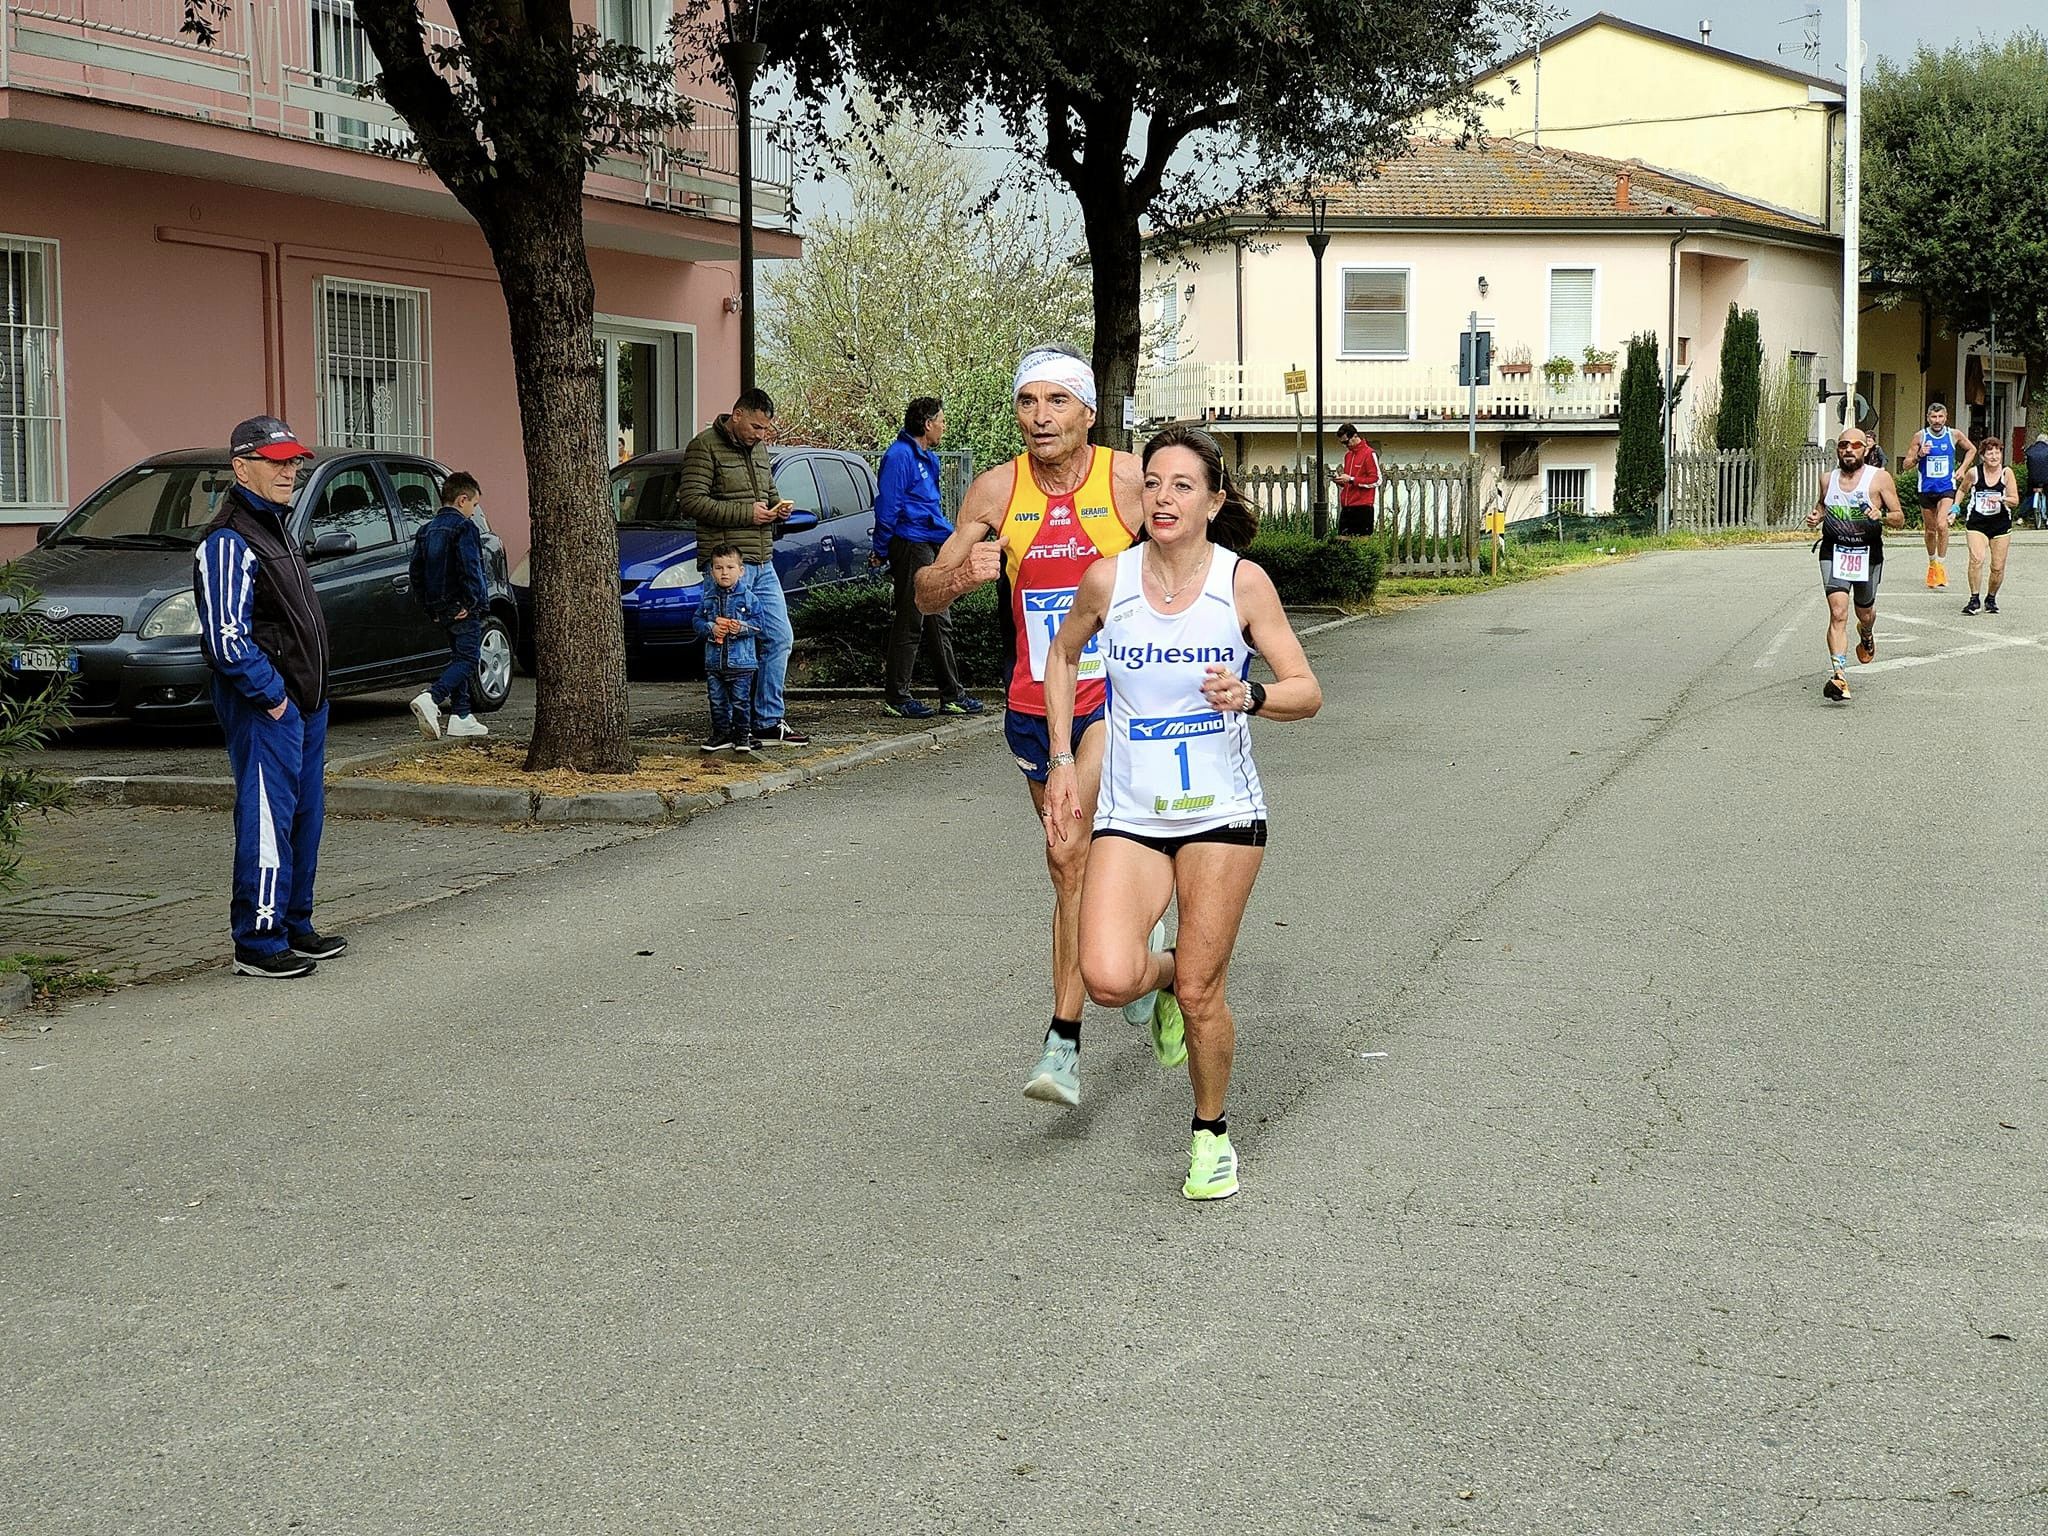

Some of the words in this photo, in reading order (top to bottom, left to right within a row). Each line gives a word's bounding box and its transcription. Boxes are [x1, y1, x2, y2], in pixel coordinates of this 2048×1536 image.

[1934, 462, 1942, 472] 81
[1015, 513, 1040, 522] AVIS
[1840, 554, 1862, 571] 289
[1108, 638, 1234, 670] lughesina
[1174, 741, 1190, 791] 1
